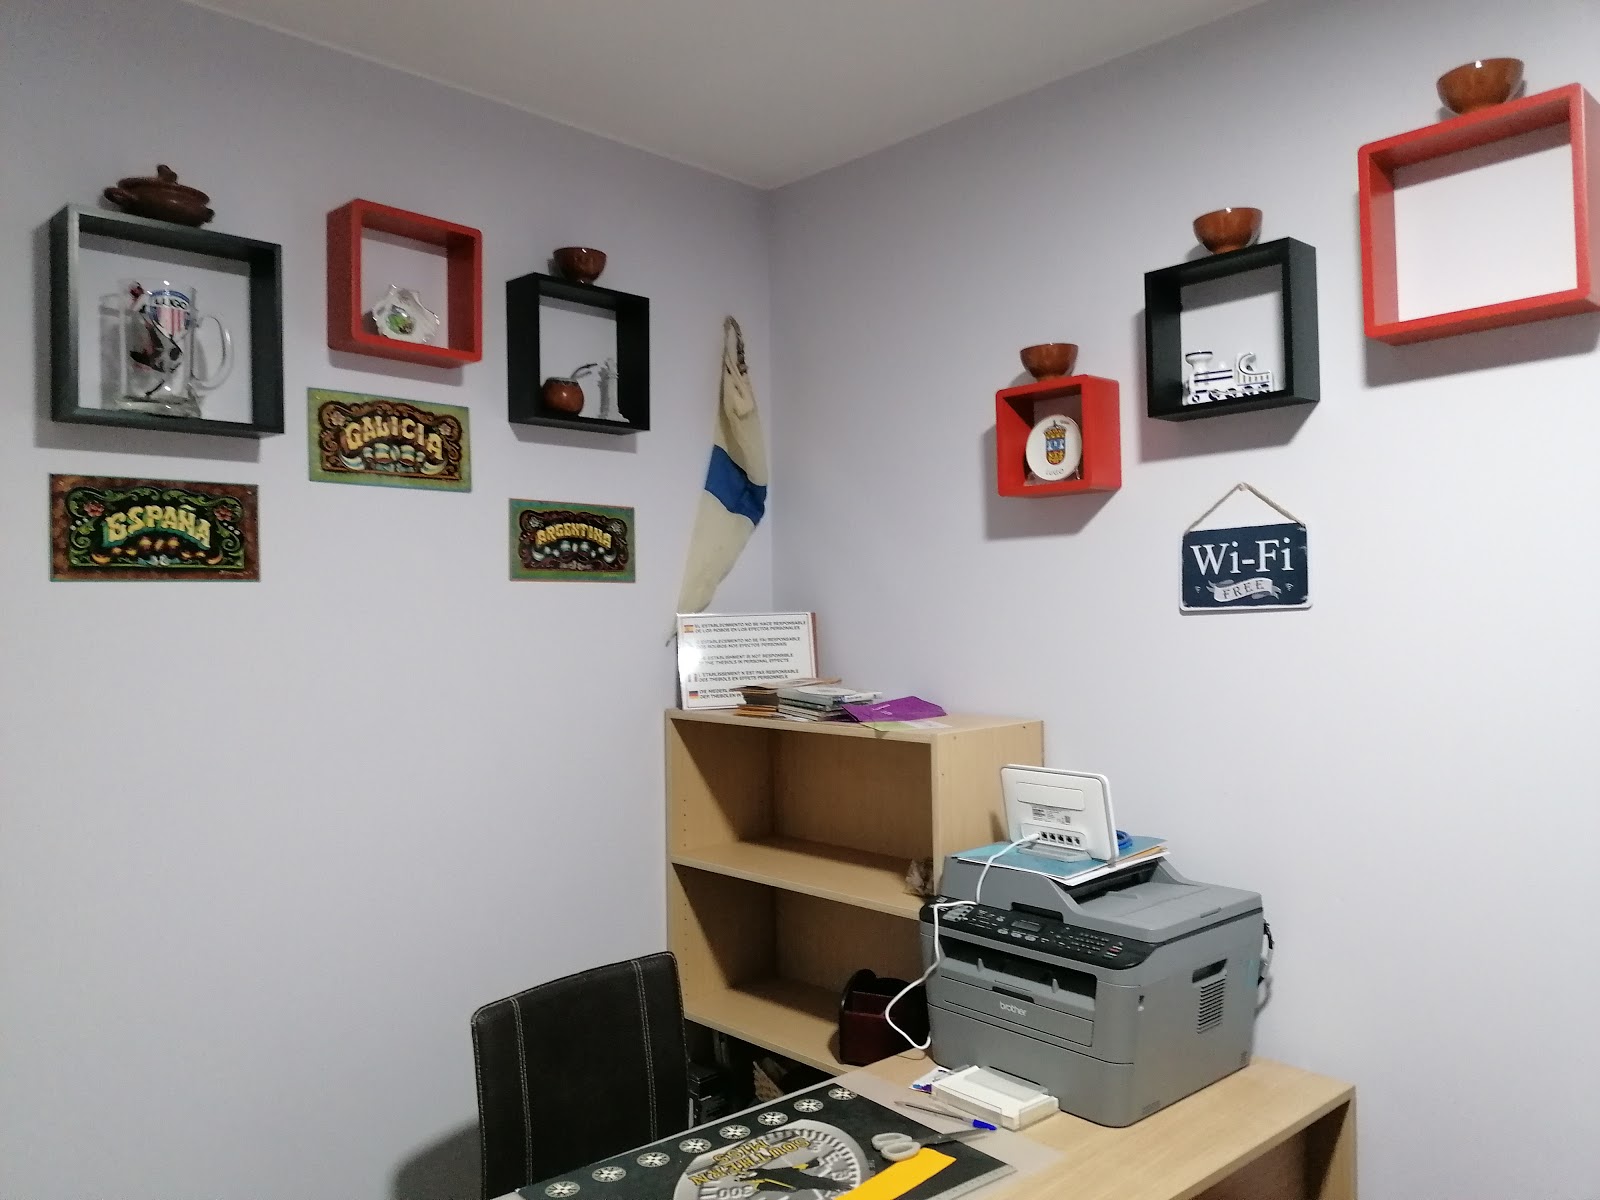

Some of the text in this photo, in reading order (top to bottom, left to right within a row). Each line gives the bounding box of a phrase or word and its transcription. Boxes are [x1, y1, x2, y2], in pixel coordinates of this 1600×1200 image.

[344, 415, 444, 462] GALICIA
[102, 503, 212, 550] ESPAÑA
[535, 523, 613, 549] ARGENTINA
[1189, 537, 1295, 576] Wi-Fi
[1221, 579, 1265, 600] FREE
[1000, 1000, 1027, 1017] brother
[688, 1136, 812, 1186] SOUTHERN
